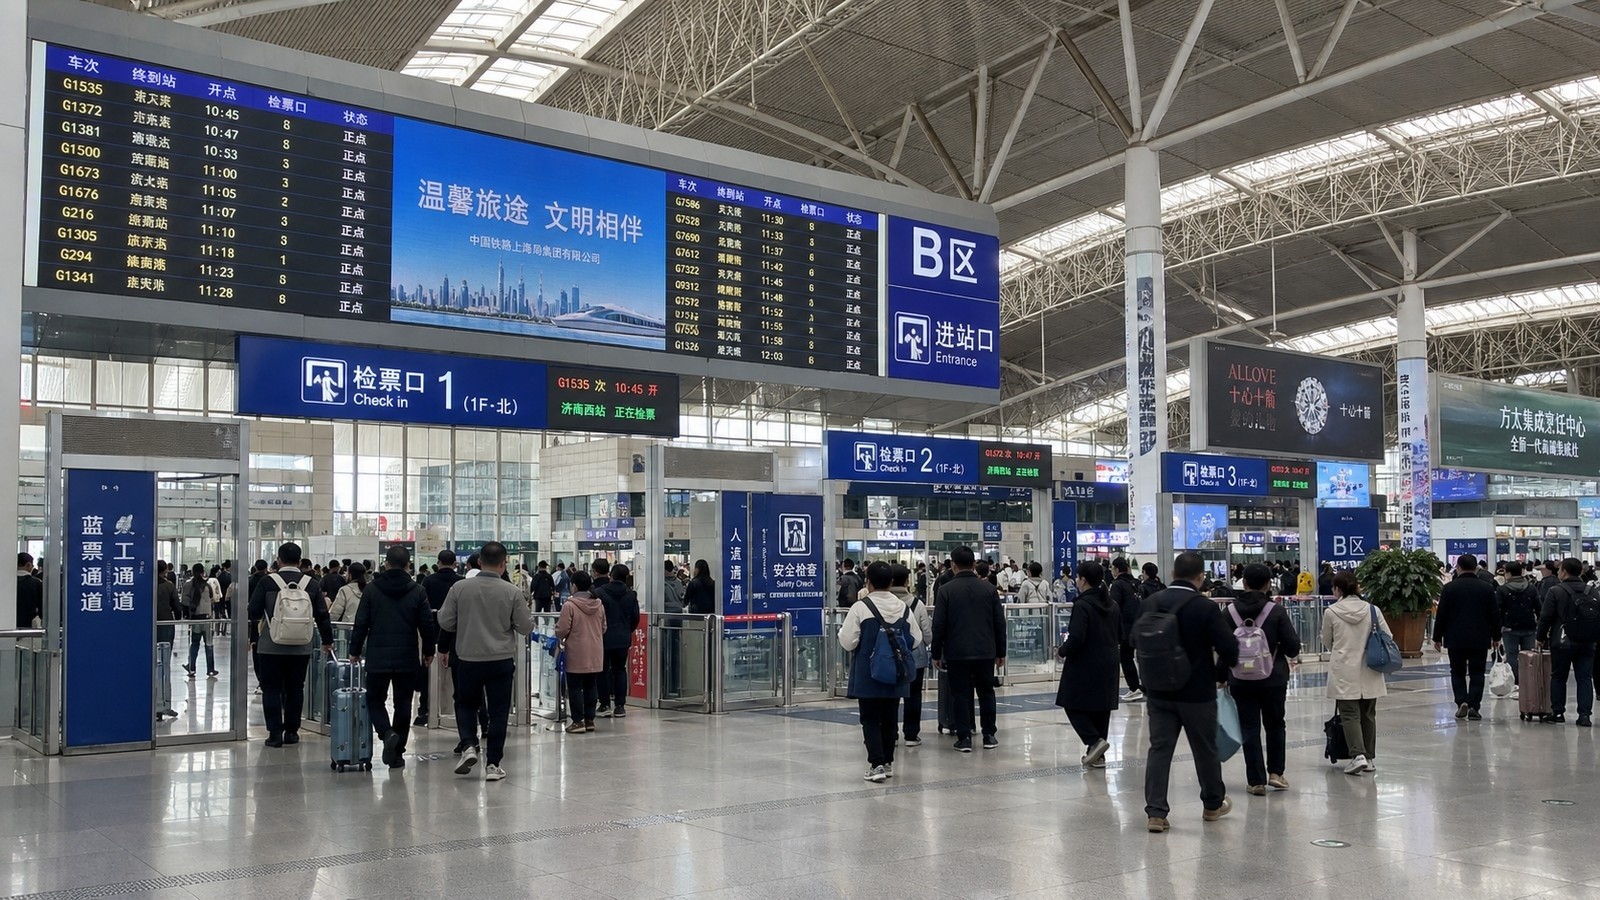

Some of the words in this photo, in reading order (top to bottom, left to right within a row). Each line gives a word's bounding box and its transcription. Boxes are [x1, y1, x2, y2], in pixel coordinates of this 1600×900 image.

[68, 55, 99, 74] 车次
[132, 67, 177, 89] 终到站
[208, 82, 237, 100] 开点
[268, 95, 307, 114] 检票口
[343, 110, 368, 126] 状态
[63, 77, 103, 95] G1535
[205, 104, 240, 121] 10:45
[283, 120, 291, 130] 8
[343, 130, 367, 146] 正点
[62, 99, 102, 117] G1372
[204, 124, 239, 140] 10:47
[282, 139, 290, 150] 8
[342, 150, 367, 164] 正点
[61, 121, 100, 138] G1381
[203, 144, 238, 160] 10:53
[342, 168, 366, 183] 正点
[61, 142, 100, 158] G1500
[203, 164, 238, 180] 11:00
[281, 178, 289, 188] 3
[341, 187, 365, 201] 正点
[60, 163, 100, 179] G1673
[202, 184, 237, 199] 11:05
[281, 196, 288, 207] 2
[341, 206, 365, 220] 正点
[678, 178, 698, 193] 车次
[764, 196, 782, 209] 开点
[800, 203, 825, 217] 检票口
[846, 212, 862, 225] 状态
[59, 185, 99, 200] G1676
[201, 204, 236, 219] 11:07
[281, 216, 288, 227] 3
[340, 224, 365, 239] 正点
[418, 178, 529, 226] 温馨旅途
[544, 201, 644, 244] 文明相伴
[761, 213, 784, 226] 11:30
[62, 206, 94, 220] G216
[201, 224, 236, 239] 11:10
[340, 243, 364, 258] 正点
[675, 213, 700, 227] G7528
[761, 229, 784, 241] 11:33
[57, 227, 97, 242] G1305
[200, 244, 235, 259] 11:18
[280, 255, 286, 265] 1
[339, 262, 364, 277] 正点
[675, 247, 700, 260] G7612
[761, 260, 783, 272] 11:42
[761, 245, 784, 257] 11:37
[913, 226, 978, 284] B区
[60, 248, 93, 262] G294
[199, 264, 234, 278] 11:23
[339, 281, 364, 295] 正点
[675, 264, 700, 276] G7322
[761, 276, 783, 288] 11:45
[55, 269, 94, 284] G1341
[199, 284, 233, 299] 11:28
[338, 300, 363, 314] 正点
[761, 291, 783, 303] 11:48
[761, 306, 783, 318] 11:52
[761, 321, 783, 332] 11:55
[935, 321, 993, 353] 进站口
[761, 335, 783, 347] 11:58
[760, 350, 783, 362] 12:03
[935, 351, 978, 367] Entrance
[352, 364, 425, 394] 检票口
[438, 370, 453, 410] 1
[558, 377, 591, 390] G1535
[594, 379, 607, 393] 次
[615, 382, 644, 395] 10:45
[648, 384, 658, 397] 开
[1228, 363, 1276, 385] ALLOVE
[353, 393, 393, 409] Check
[396, 394, 409, 409] in
[614, 406, 656, 421] 正在检票
[879, 446, 916, 464] 检票口
[920, 447, 933, 473] 2
[1228, 466, 1236, 487] 3
[1333, 535, 1365, 556] B区
[81, 514, 104, 612] 蓝票通道
[113, 514, 135, 612] 工通道
[773, 562, 818, 578] 安全检查
